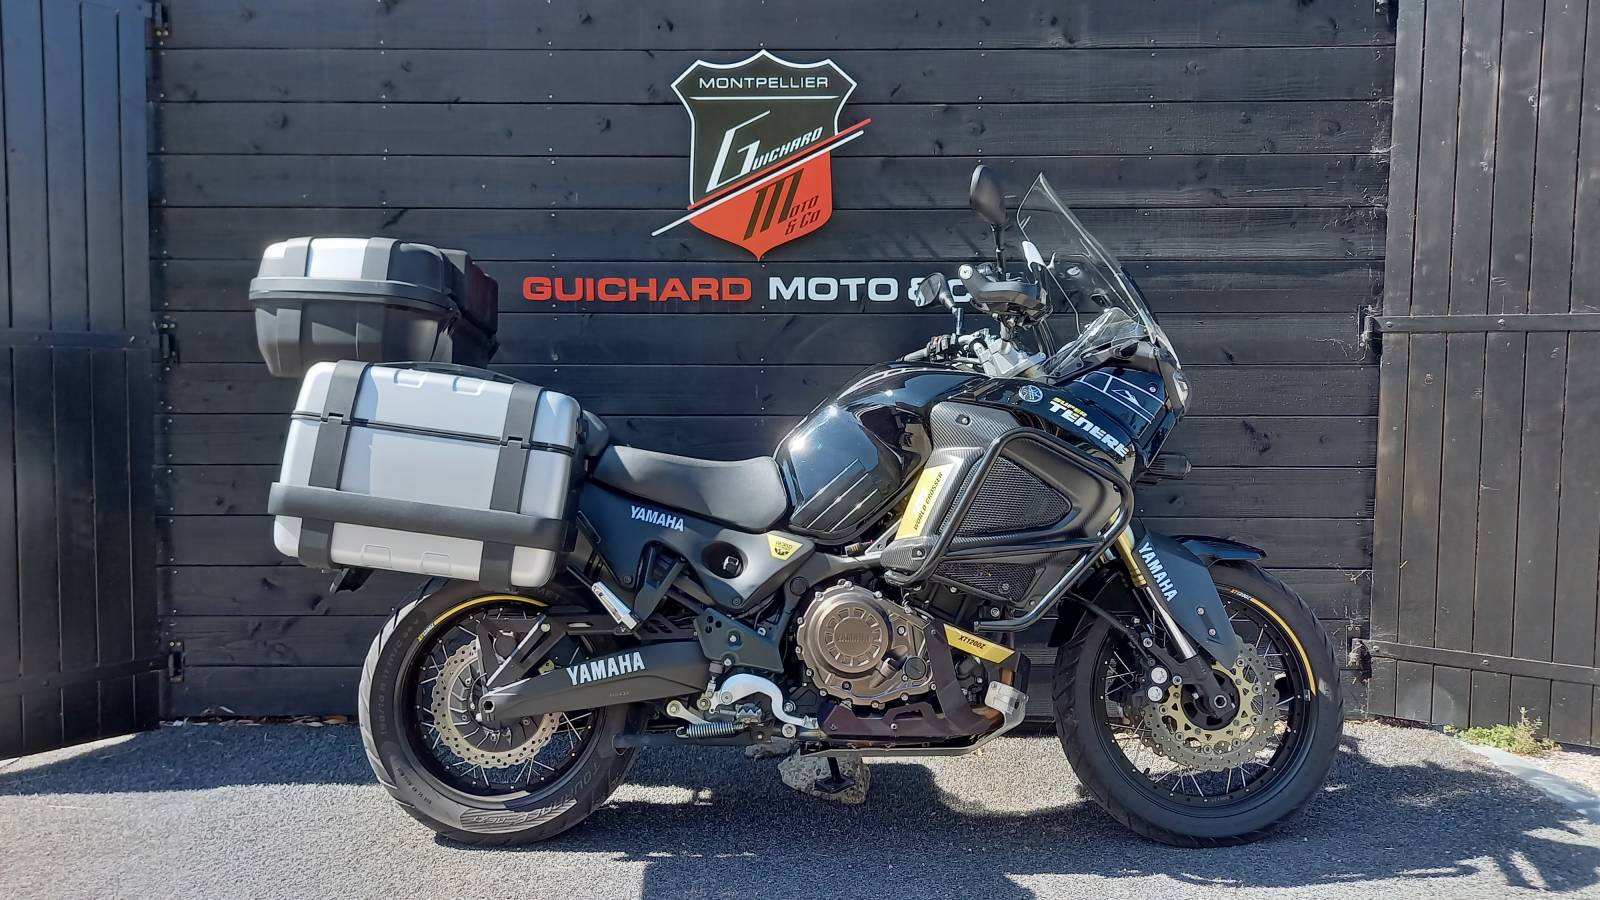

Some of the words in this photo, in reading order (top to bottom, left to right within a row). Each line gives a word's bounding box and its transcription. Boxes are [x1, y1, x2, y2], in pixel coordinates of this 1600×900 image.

[699, 76, 828, 89] MONTPELLIER
[522, 276, 752, 301] GUICHARD
[769, 277, 898, 301] MOTO
[913, 504, 927, 530] WORLD
[925, 471, 943, 504] CROSSER
[630, 505, 685, 532] YAMAHA
[1138, 542, 1178, 602] YAMAHA
[959, 635, 986, 649] XT1200Z
[566, 651, 646, 687] YAMAHA
